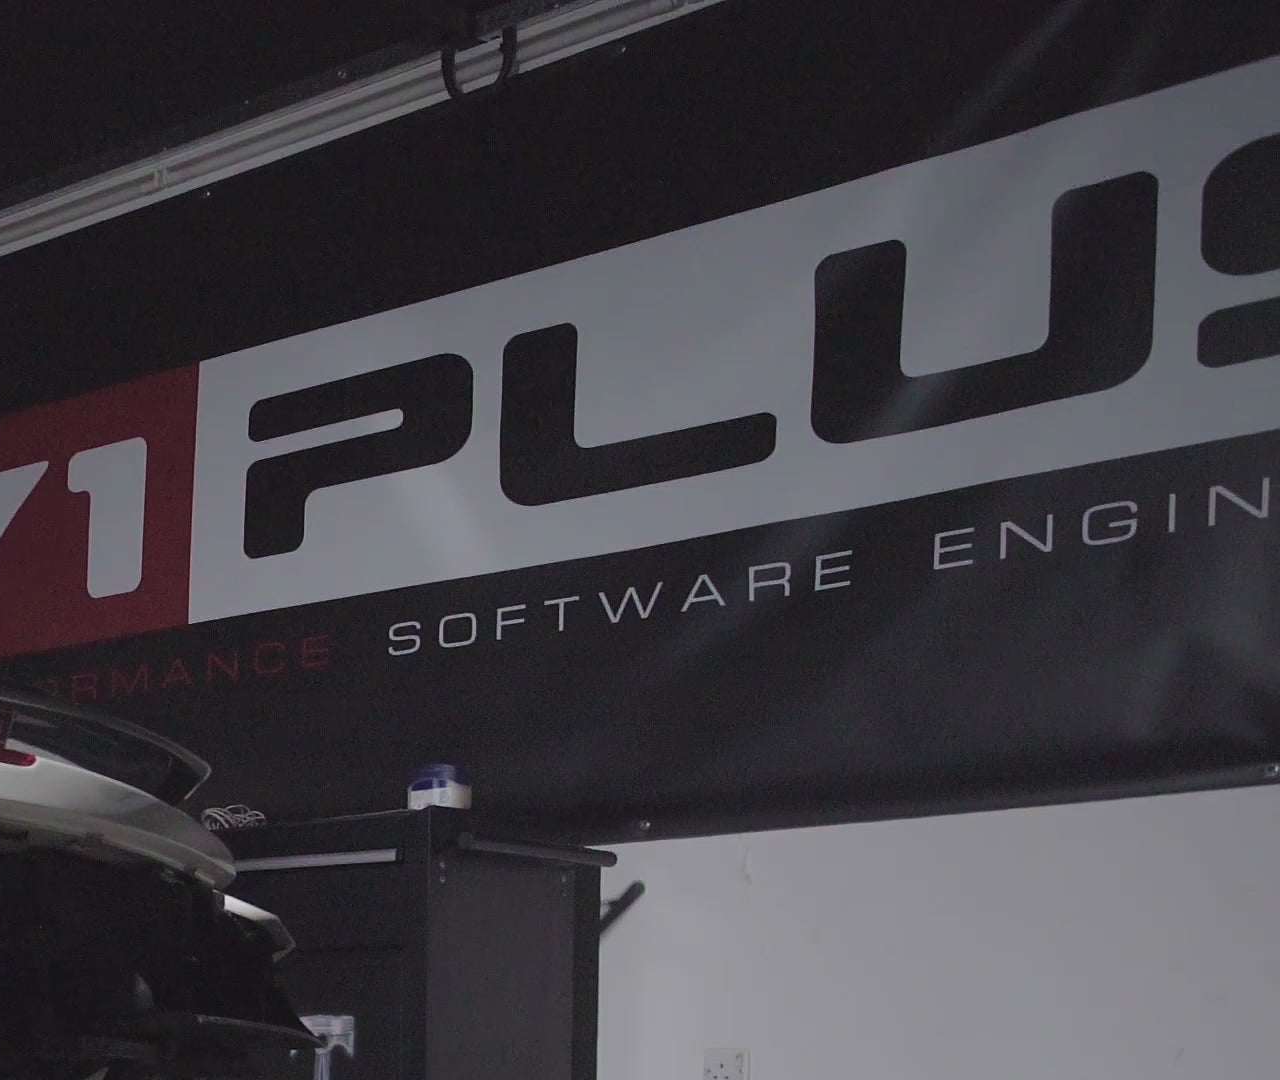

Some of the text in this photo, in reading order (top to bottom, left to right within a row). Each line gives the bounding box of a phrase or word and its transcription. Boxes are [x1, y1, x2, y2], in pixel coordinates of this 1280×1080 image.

[243, 132, 1280, 559] PLU
[386, 549, 853, 656] SOFTWARE
[932, 476, 1270, 571] ENGIN
